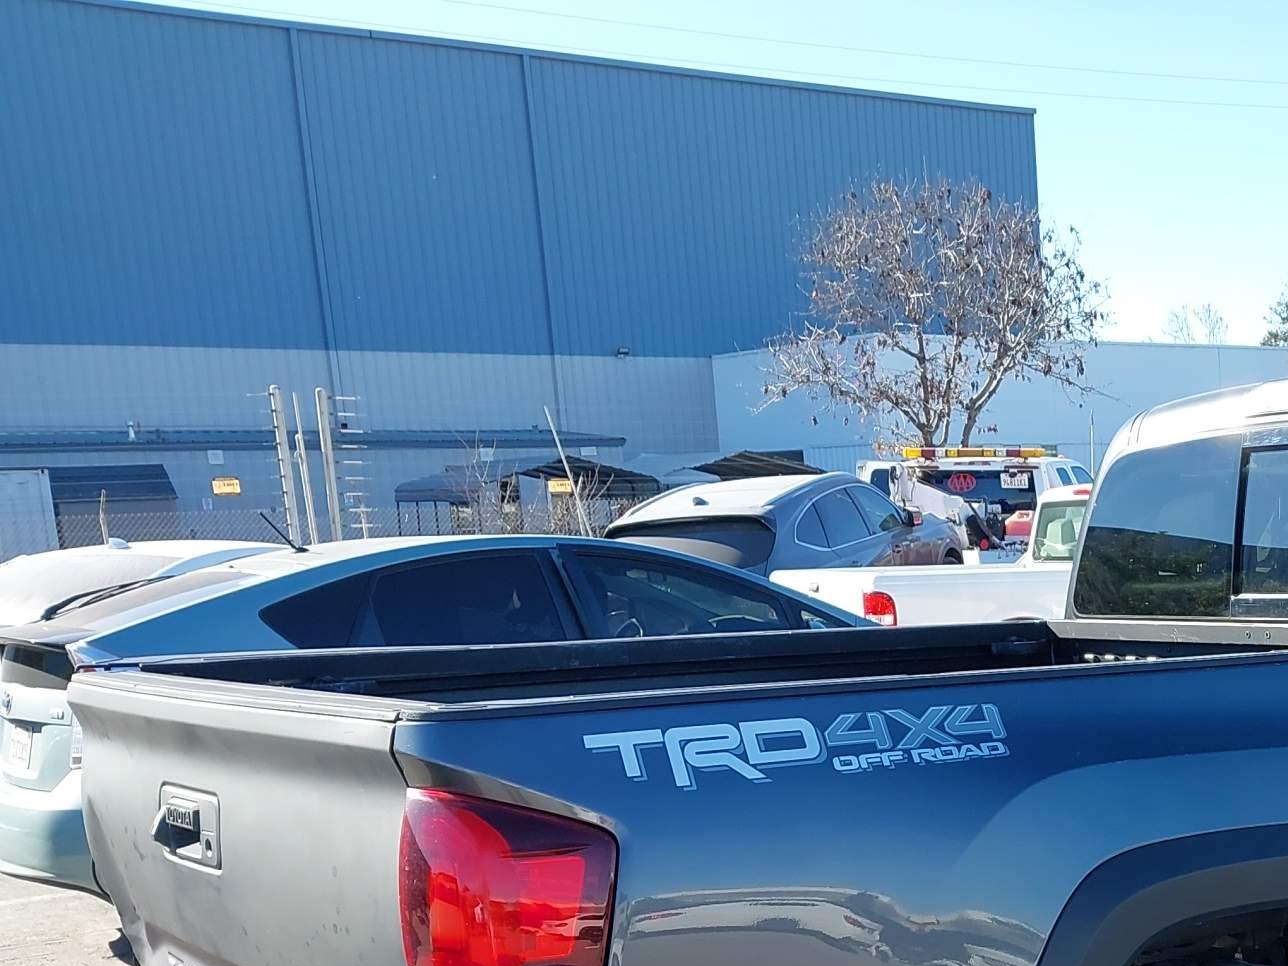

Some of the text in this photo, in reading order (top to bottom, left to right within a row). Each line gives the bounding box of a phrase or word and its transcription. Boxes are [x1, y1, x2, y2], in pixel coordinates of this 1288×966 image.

[583, 717, 824, 792] TRD
[833, 741, 1010, 774] OFF ROAD
